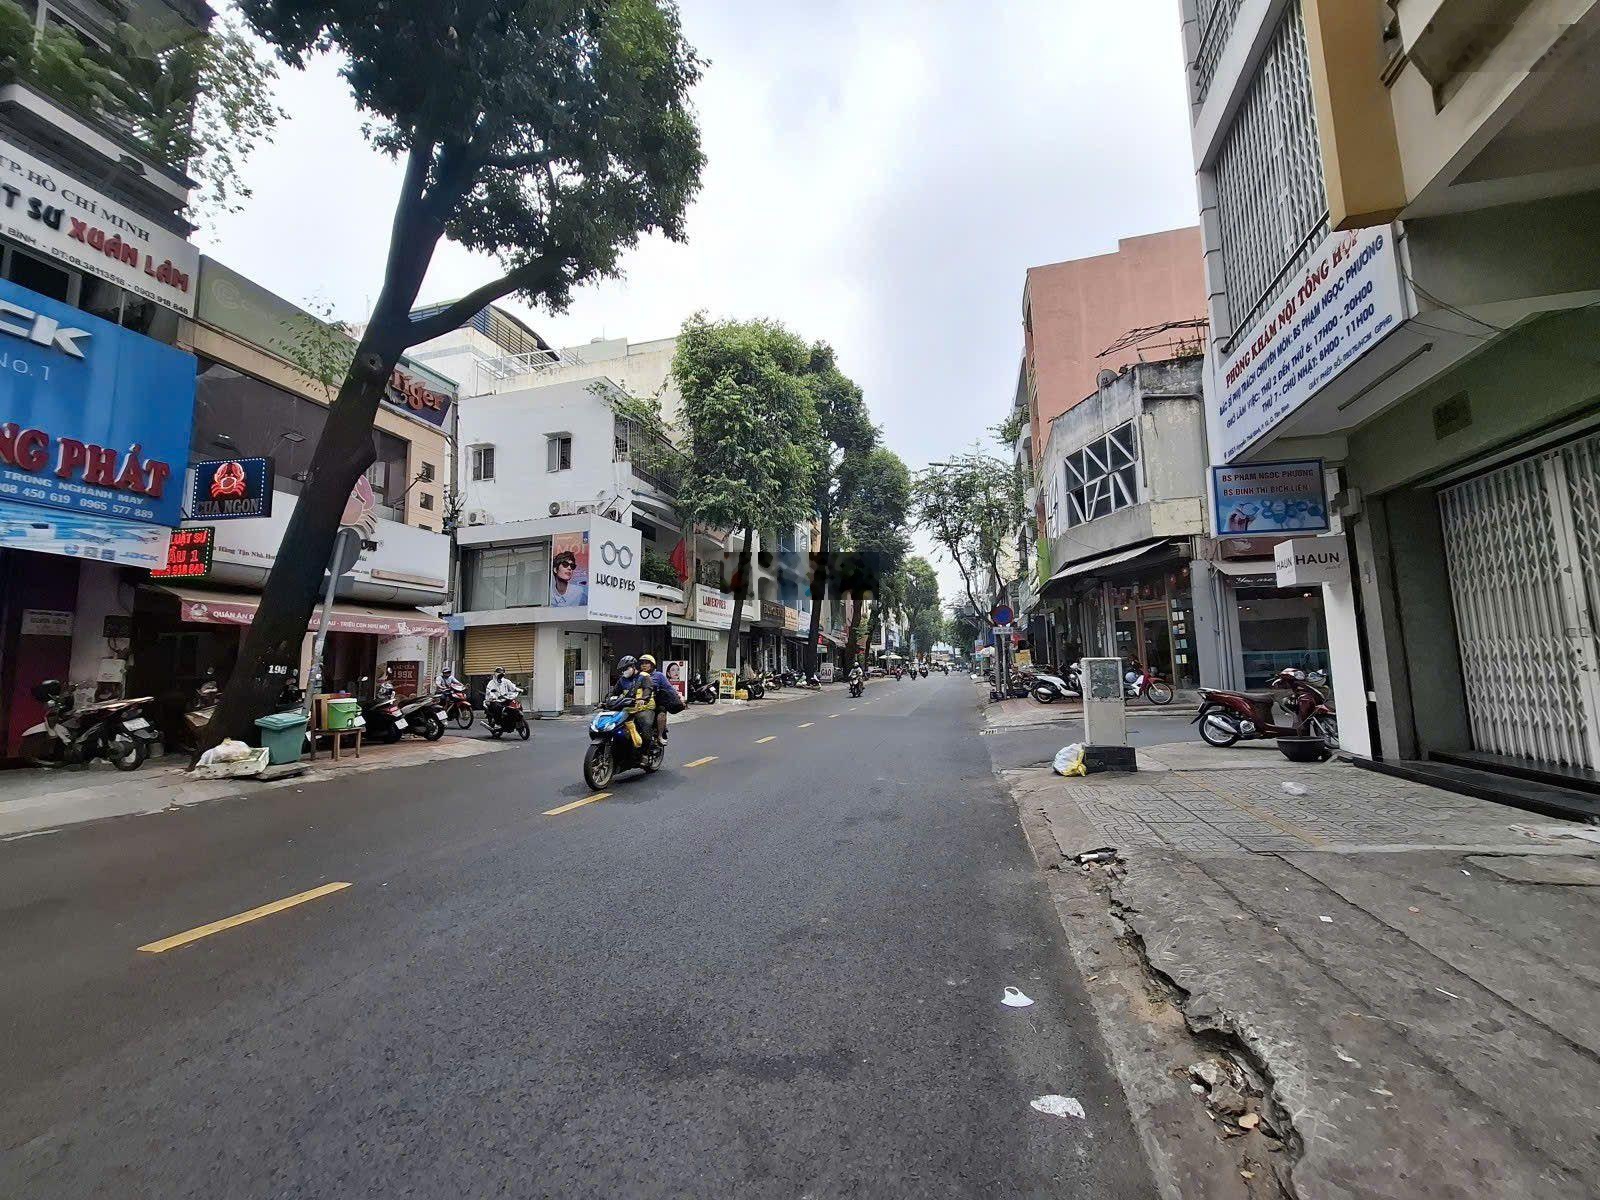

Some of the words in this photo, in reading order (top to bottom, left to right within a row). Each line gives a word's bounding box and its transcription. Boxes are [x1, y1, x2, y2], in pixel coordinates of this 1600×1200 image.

[101, 208, 150, 242] MINH
[67, 216, 138, 268] XUÂN
[144, 255, 189, 292] LÂM
[1293, 324, 1301, 340] BS
[1301, 302, 1320, 331] PHẠM
[1321, 276, 1345, 310] NGỌC
[1345, 234, 1384, 284] PHƯƠNG
[1226, 351, 1250, 388] PHÒNG
[1251, 319, 1277, 360] KHÁM
[1278, 296, 1296, 329] NỘI
[1272, 375, 1278, 386] 2
[1314, 315, 1338, 346] 17H00
[1343, 280, 1373, 317] 20H00
[1319, 335, 1340, 361] 8H00
[1346, 303, 1374, 337] 11H00
[54, 437, 170, 497] PHÁT
[4, 471, 52, 487] TRONG
[118, 494, 144, 505] MAY
[22, 488, 46, 500] 450
[50, 492, 71, 504] 619
[112, 504, 132, 515] 577
[134, 508, 154, 519] 889
[223, 498, 259, 514] NGON
[1295, 552, 1339, 566] HAUN
[595, 573, 619, 588] LUCID
[620, 579, 636, 591] EYES
[213, 610, 235, 619] QUÁN
[268, 664, 287, 675] 198
